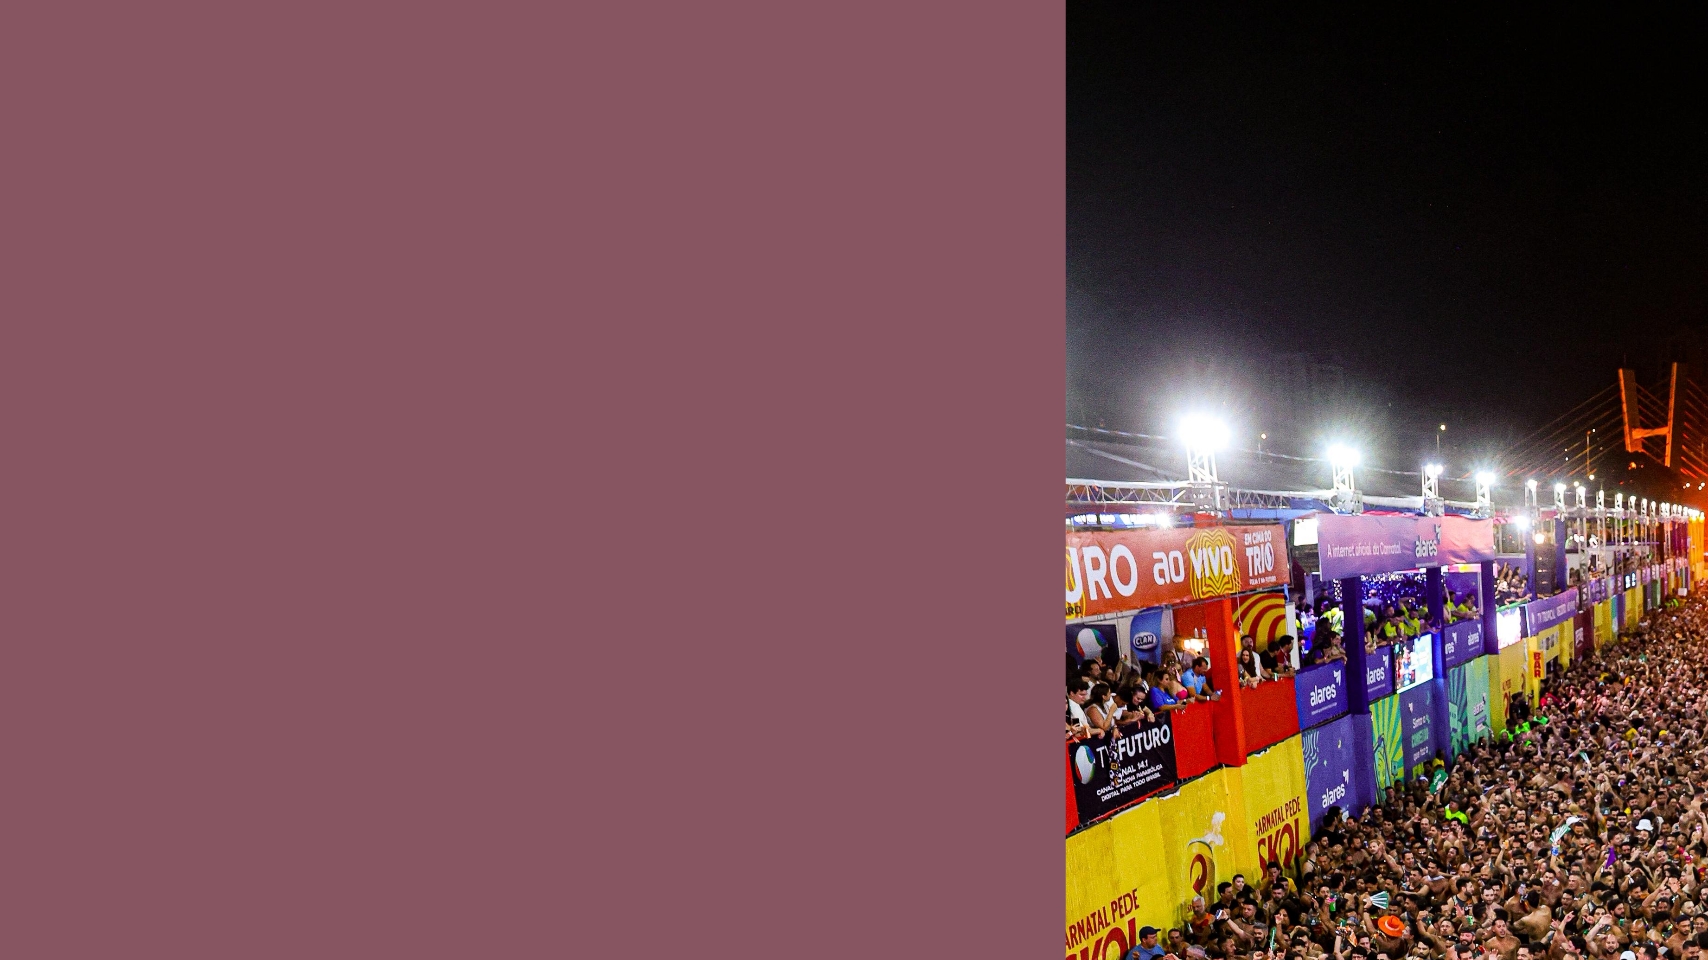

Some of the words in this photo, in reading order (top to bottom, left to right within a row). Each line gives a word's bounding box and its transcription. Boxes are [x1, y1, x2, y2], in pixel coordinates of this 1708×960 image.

[1415, 535, 1438, 558] alares
[1153, 550, 1185, 586] ao
[1189, 545, 1234, 580] VIVO
[1245, 541, 1275, 577] TRIO
[1066, 603, 1082, 616] RO
[1135, 635, 1154, 647] CLAN
[1366, 667, 1385, 685] lares
[1533, 651, 1542, 678] BAR
[1310, 684, 1336, 706] alares
[1118, 724, 1171, 761] FUTURO
[1137, 759, 1149, 770] 14.1
[1101, 789, 1120, 802] DIGITAL
[1120, 784, 1133, 794] PARA
[1133, 778, 1146, 788] TODO
[1145, 772, 1162, 782] BRASIL
[1121, 775, 1136, 785] NOVA
[1322, 783, 1346, 808] alares
[1285, 796, 1302, 820] PEDE
[1257, 818, 1304, 881] SKOL
[1110, 888, 1139, 924] PEDE
